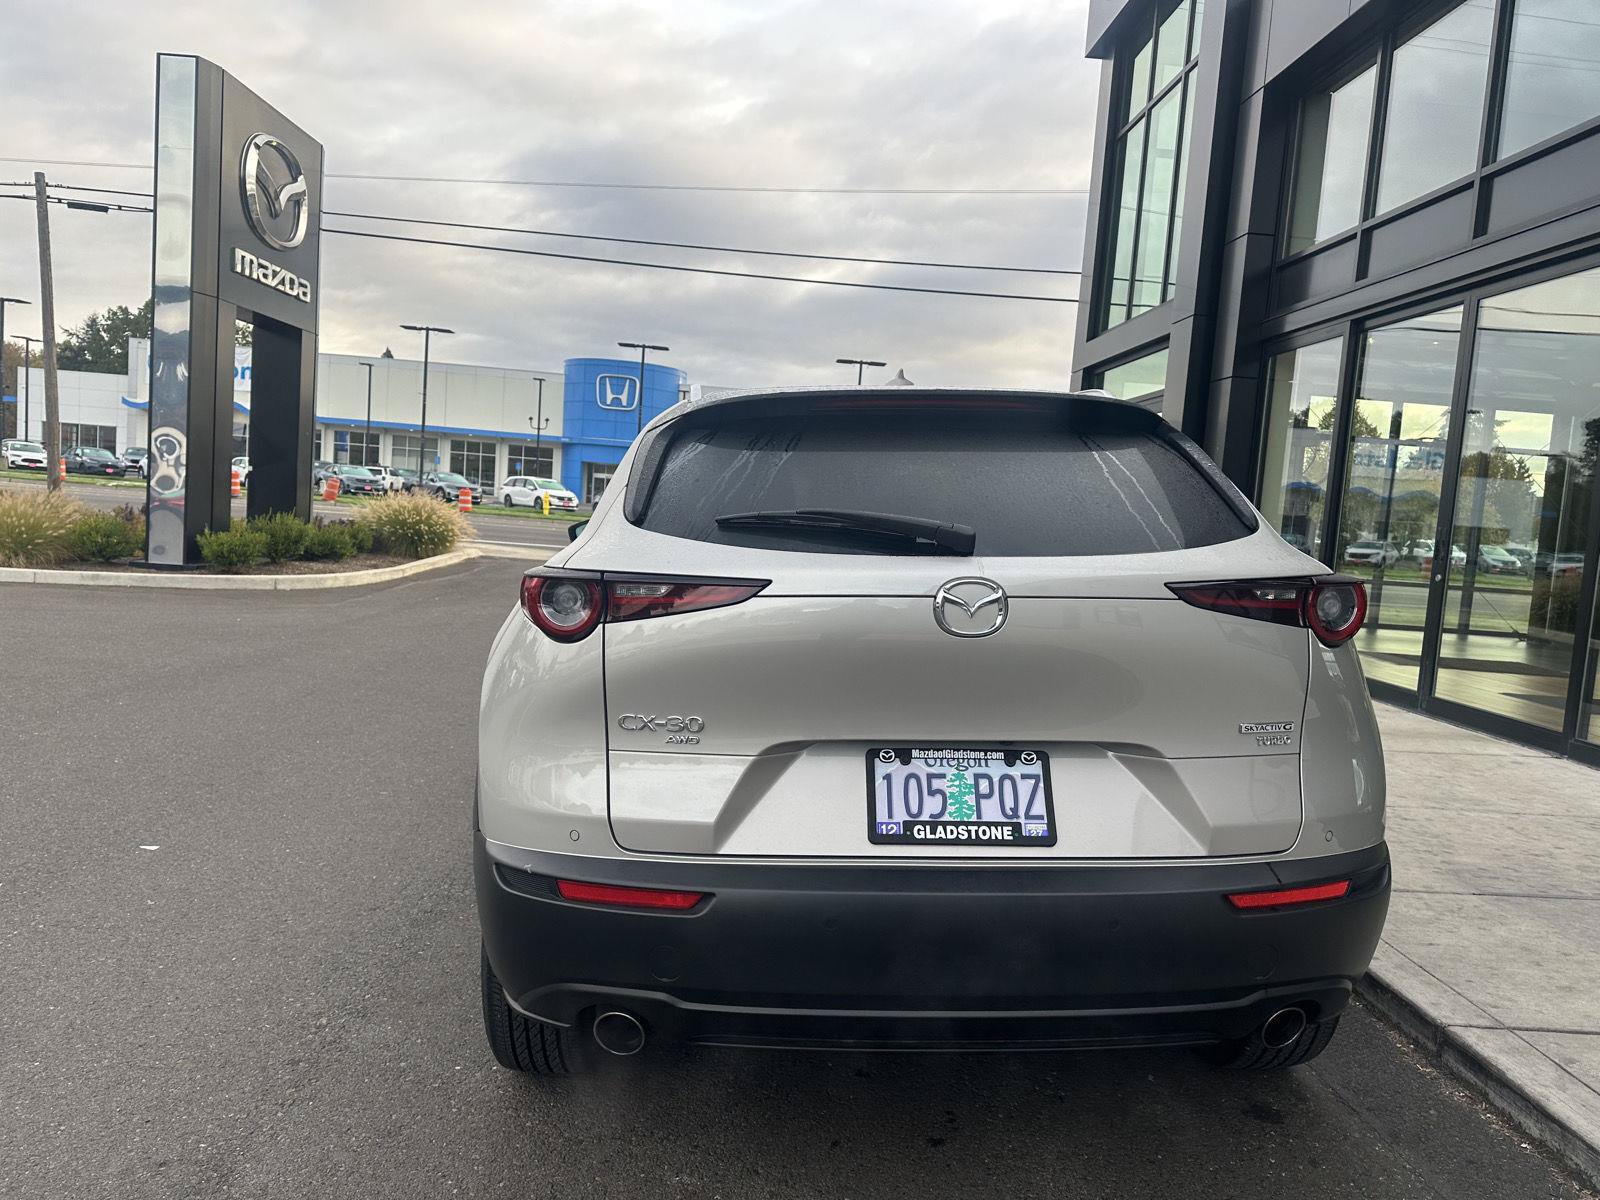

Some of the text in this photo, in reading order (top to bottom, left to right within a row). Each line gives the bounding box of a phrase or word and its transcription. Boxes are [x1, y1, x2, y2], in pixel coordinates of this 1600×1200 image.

[235, 248, 311, 303] mazda
[618, 713, 705, 733] CX-30
[665, 735, 701, 744] AWD
[1256, 735, 1291, 746] TURBO
[911, 749, 1005, 760] MazdaofGladstone.com
[882, 772, 1045, 821] 105 PQZ
[913, 825, 1014, 840] GLADSTONE
